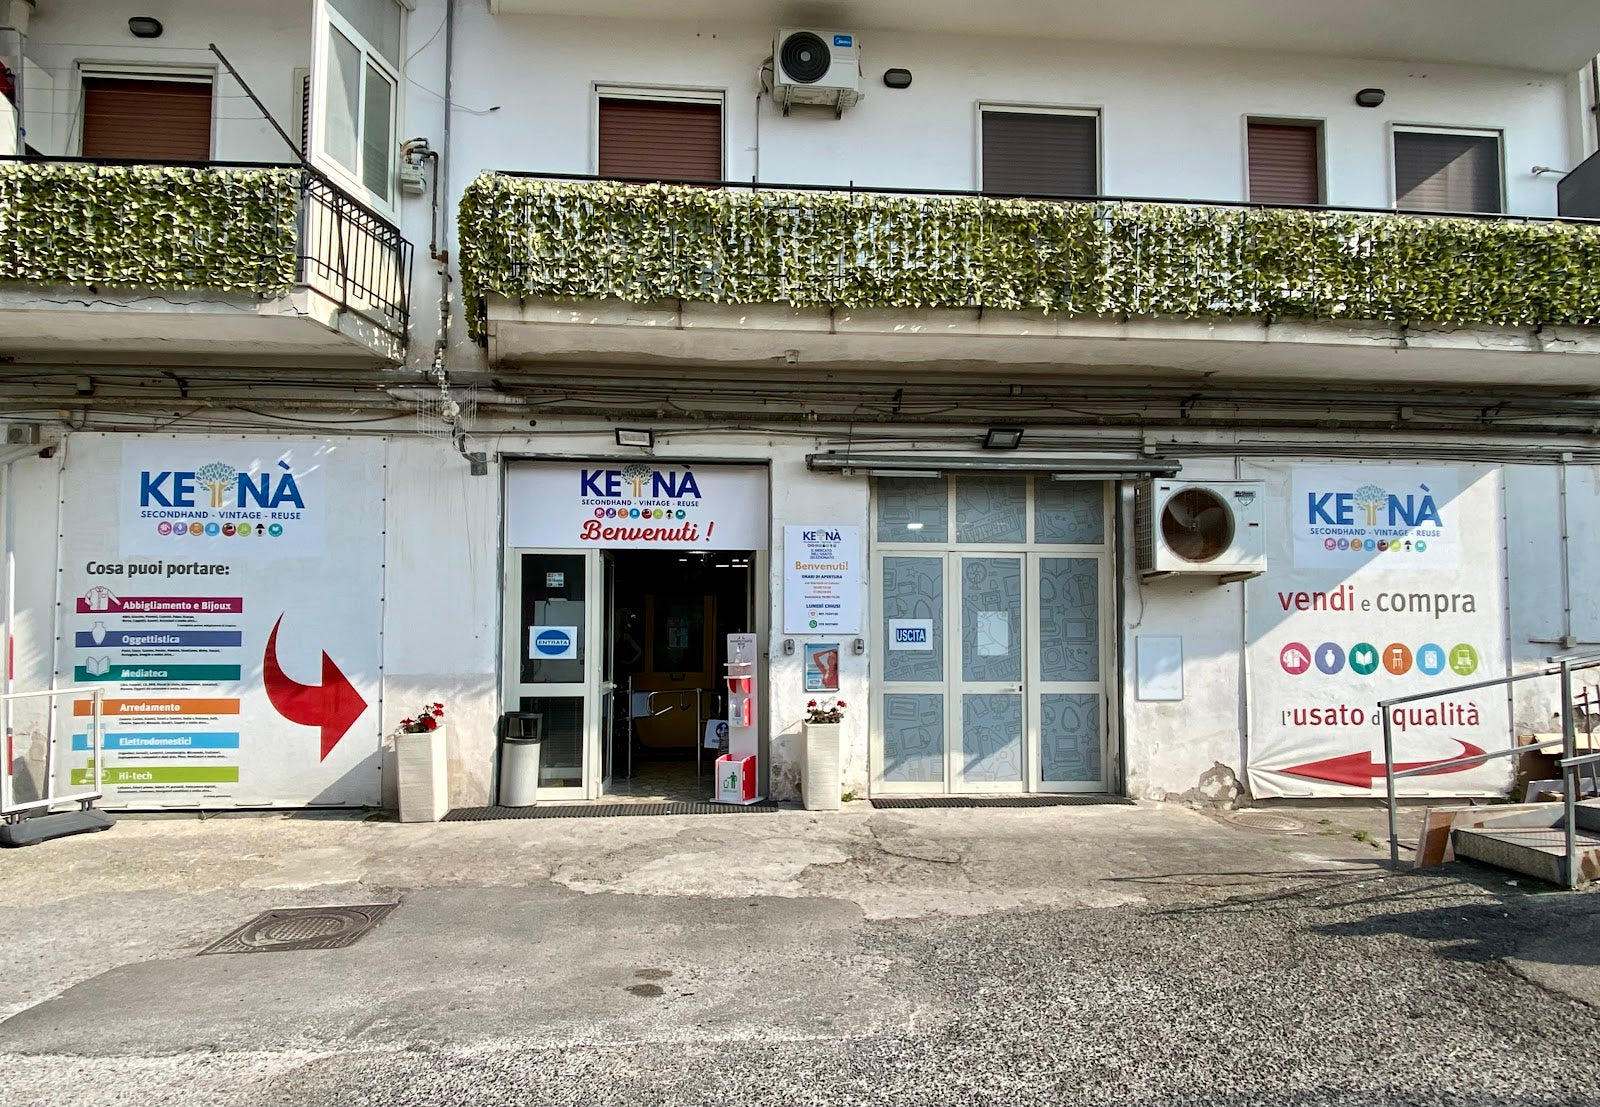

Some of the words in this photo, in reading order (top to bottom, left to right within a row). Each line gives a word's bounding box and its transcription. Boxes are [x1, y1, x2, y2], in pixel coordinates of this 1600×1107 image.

[140, 510, 209, 519] SECONDHAND
[218, 511, 261, 519] VINTAGE
[271, 512, 301, 520] REUSE
[580, 519, 700, 542] Benvenuti
[1310, 528, 1366, 536] SECONDHAND
[1374, 529, 1409, 537] VINTAGE
[86, 561, 124, 575] Cosa
[128, 560, 162, 578] puoi
[167, 562, 230, 578] portare:
[795, 561, 849, 570] Benvenuti!
[122, 601, 192, 611] Abbigliamento
[201, 601, 231, 611] Bijoux
[1278, 584, 1355, 611] vendi
[1361, 599, 1371, 612] e
[1376, 592, 1476, 619] compra
[122, 634, 180, 645] Oggettistica
[896, 629, 926, 642] USCITA
[120, 668, 168, 678] Mediateca
[119, 702, 181, 712] Arredamento
[1392, 702, 1480, 732] qualità
[119, 736, 192, 746] Elettrodomestici
[118, 771, 153, 780] Hi-tech
